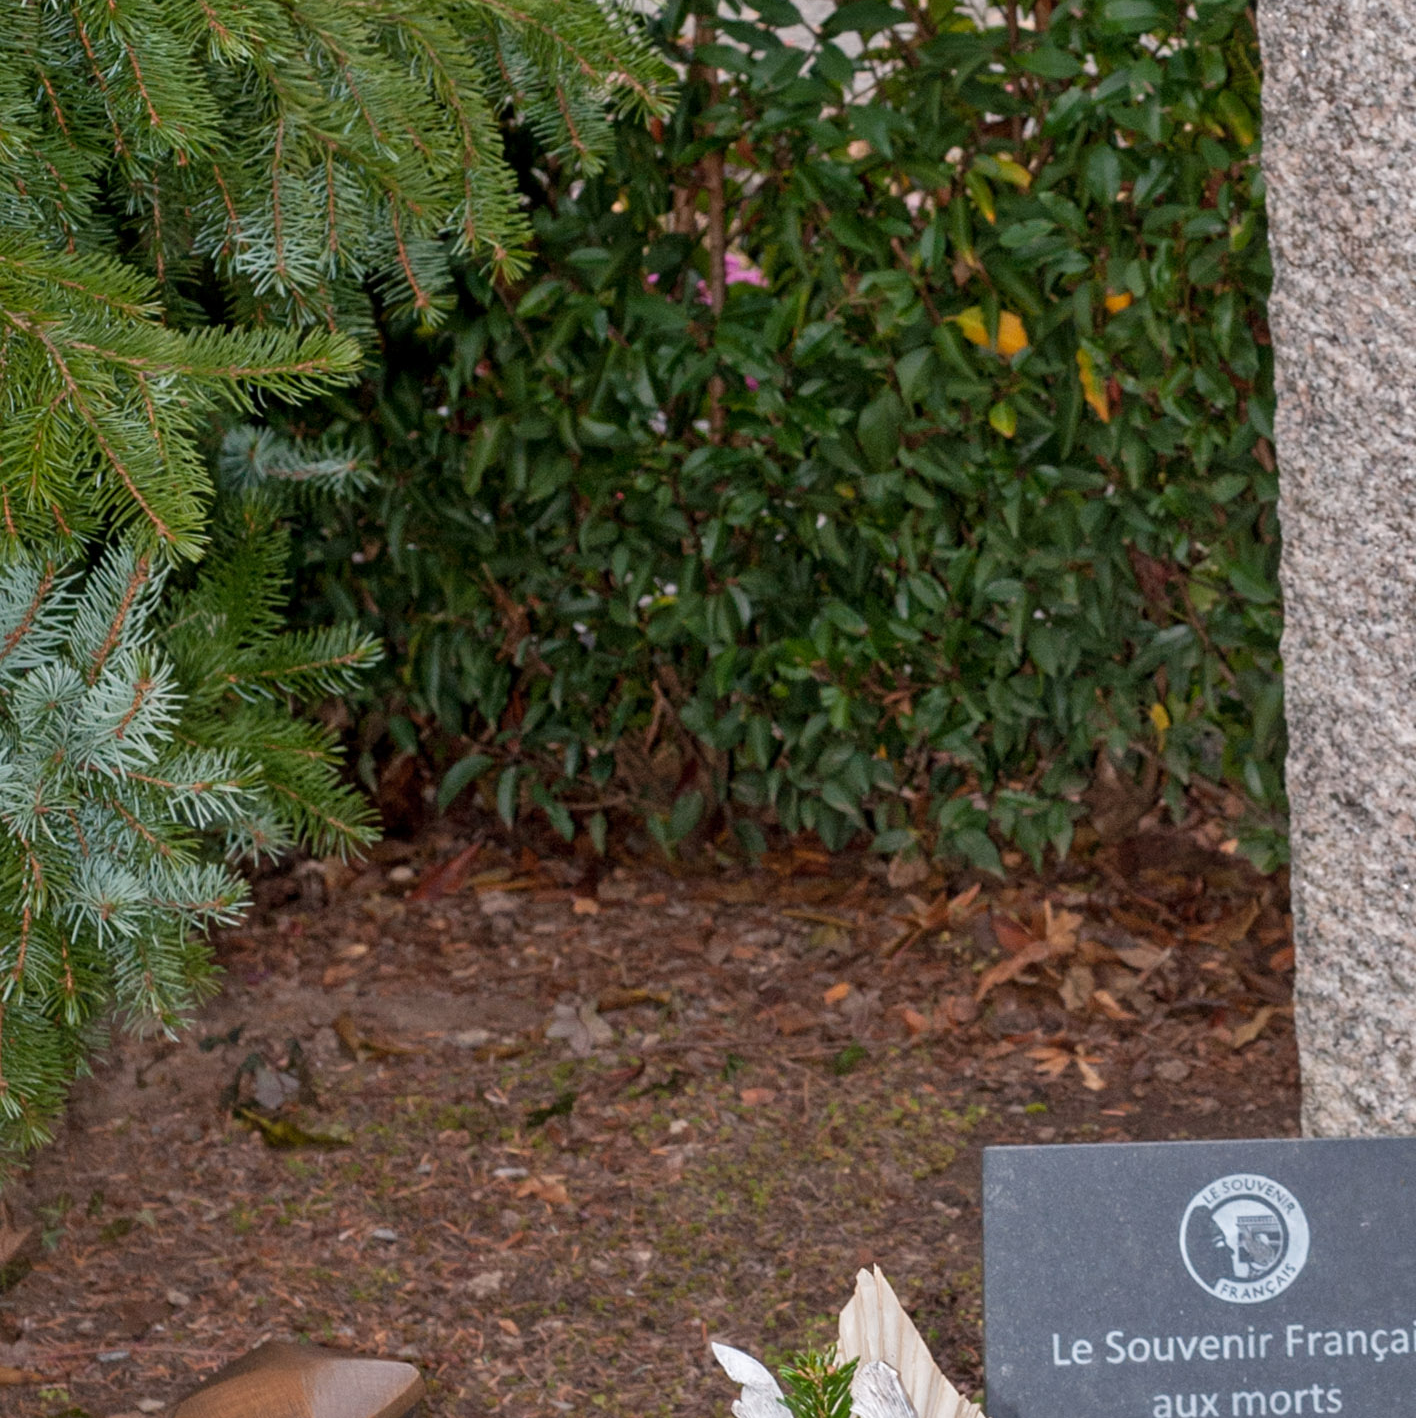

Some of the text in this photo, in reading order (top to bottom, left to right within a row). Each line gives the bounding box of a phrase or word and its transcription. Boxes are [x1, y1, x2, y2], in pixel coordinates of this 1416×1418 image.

[1201, 1177, 1297, 1215] LE SOUVENIR
[1219, 1262, 1297, 1300] FRANÇAIS
[1051, 1332, 1094, 1366] Le
[1105, 1327, 1274, 1365] Souvenir
[1231, 1382, 1344, 1417] morts
